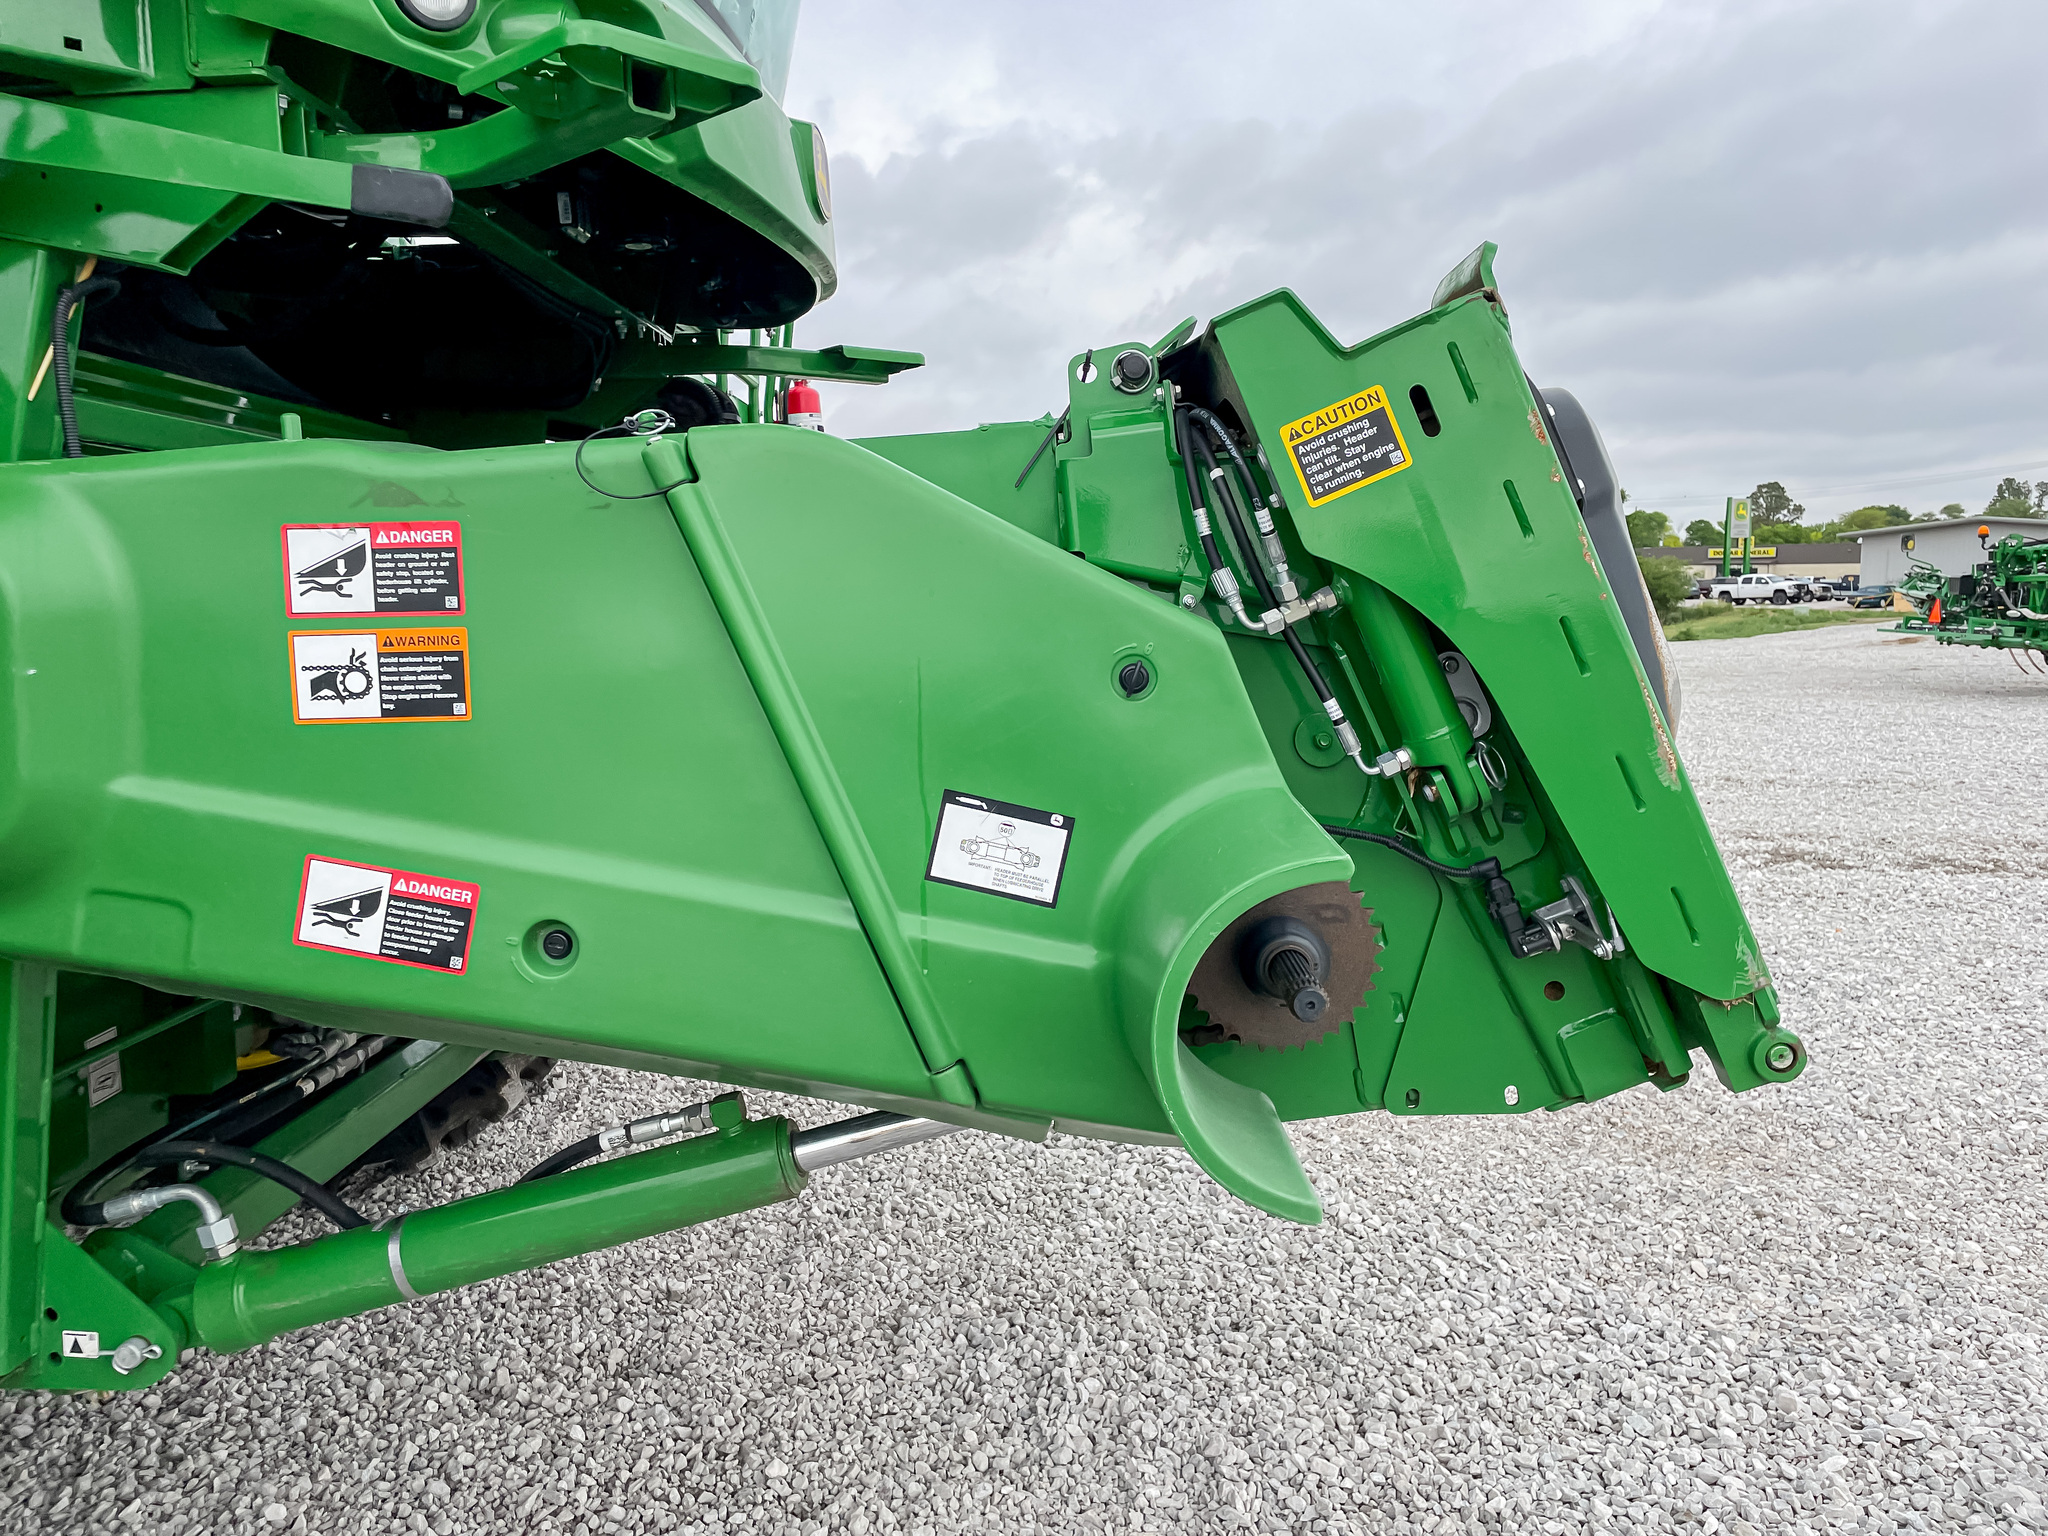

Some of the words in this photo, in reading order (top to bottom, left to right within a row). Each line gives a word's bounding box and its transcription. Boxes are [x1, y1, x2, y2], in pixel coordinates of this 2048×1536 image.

[1301, 390, 1381, 434] CAUTION
[1299, 437, 1326, 455] Avoid
[1327, 419, 1370, 442] crushing
[1301, 444, 1340, 464] injuries.
[1344, 426, 1378, 446] Header
[1306, 463, 1323, 474] can
[1325, 453, 1341, 466] tilt.
[1344, 443, 1366, 457] Stay
[1310, 469, 1333, 484] clear
[1335, 457, 1361, 474] when
[1362, 443, 1395, 462] engine
[1325, 468, 1364, 489] running.
[390, 530, 453, 543] DANGER
[395, 635, 460, 646] WARNING
[409, 881, 472, 903] DANGER
